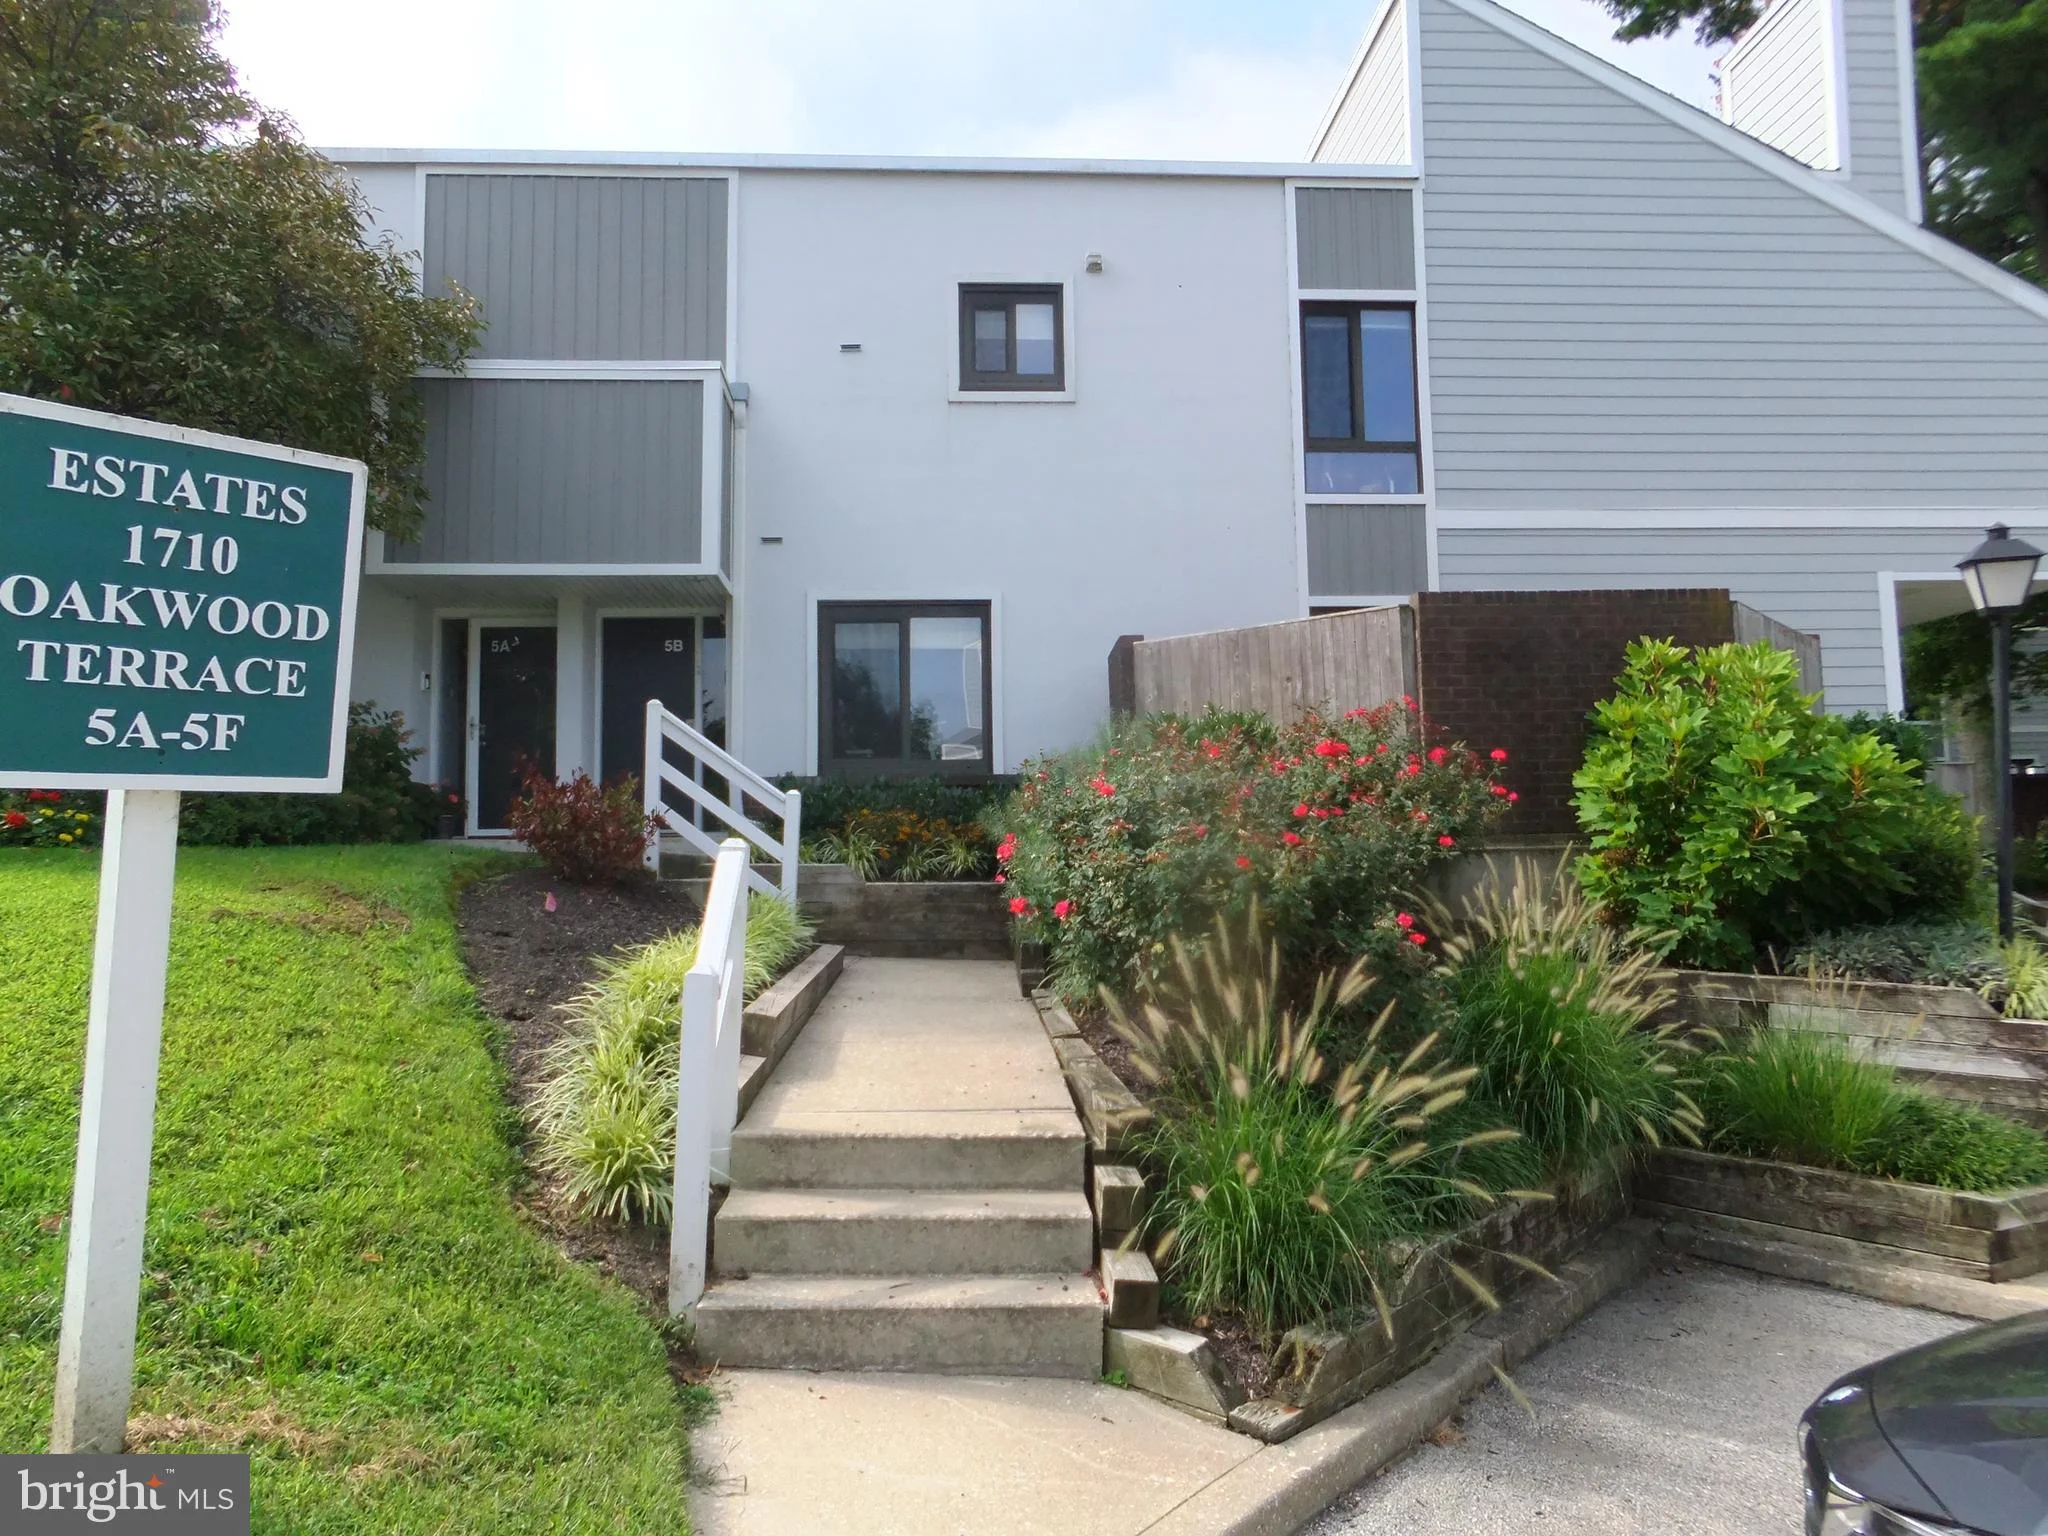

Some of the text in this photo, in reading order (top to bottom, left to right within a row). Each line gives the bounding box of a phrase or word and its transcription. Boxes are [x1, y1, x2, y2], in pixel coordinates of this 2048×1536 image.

[48, 447, 307, 524] ESTATES
[123, 525, 238, 574] 1710
[0, 575, 330, 641] OAKWOOD
[17, 640, 306, 697] TERRACE
[491, 640, 511, 652] 5A
[664, 639, 684, 652] 5B
[85, 708, 245, 751] 5A-5F
